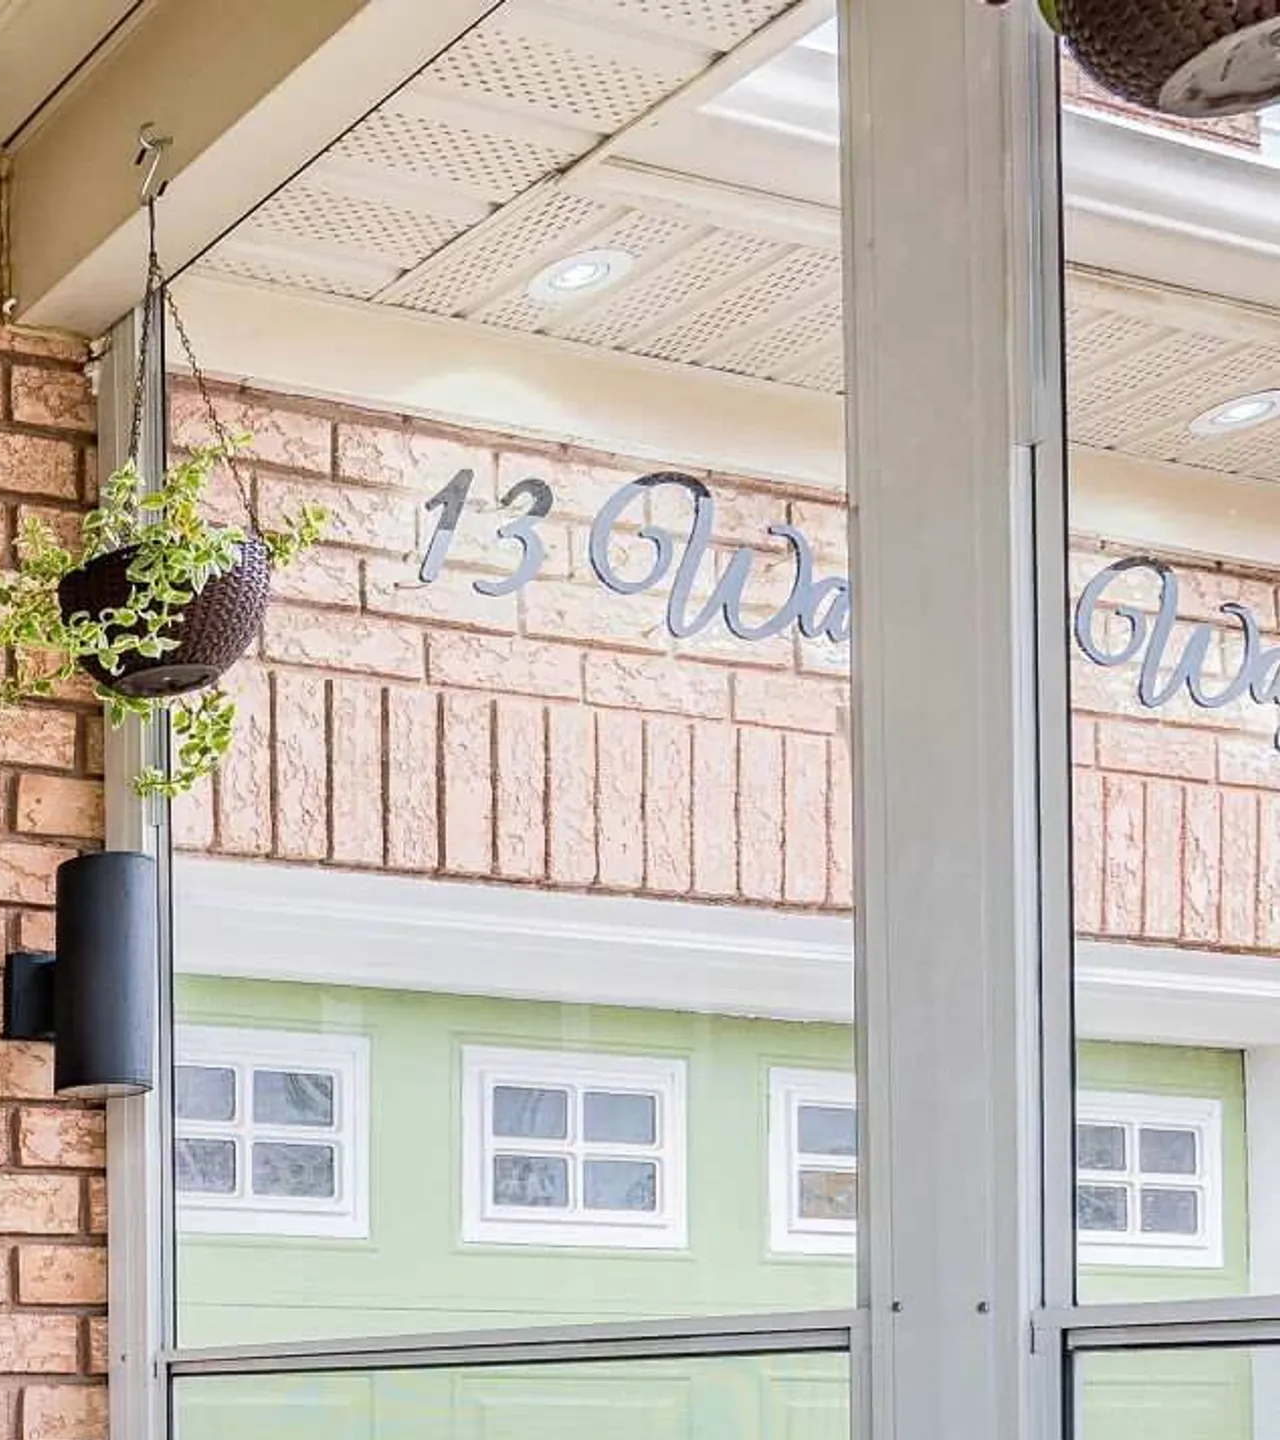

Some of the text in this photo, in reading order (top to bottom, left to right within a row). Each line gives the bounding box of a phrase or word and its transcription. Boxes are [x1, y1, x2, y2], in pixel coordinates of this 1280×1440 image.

[418, 467, 1280, 750] 13 Wa Wa
